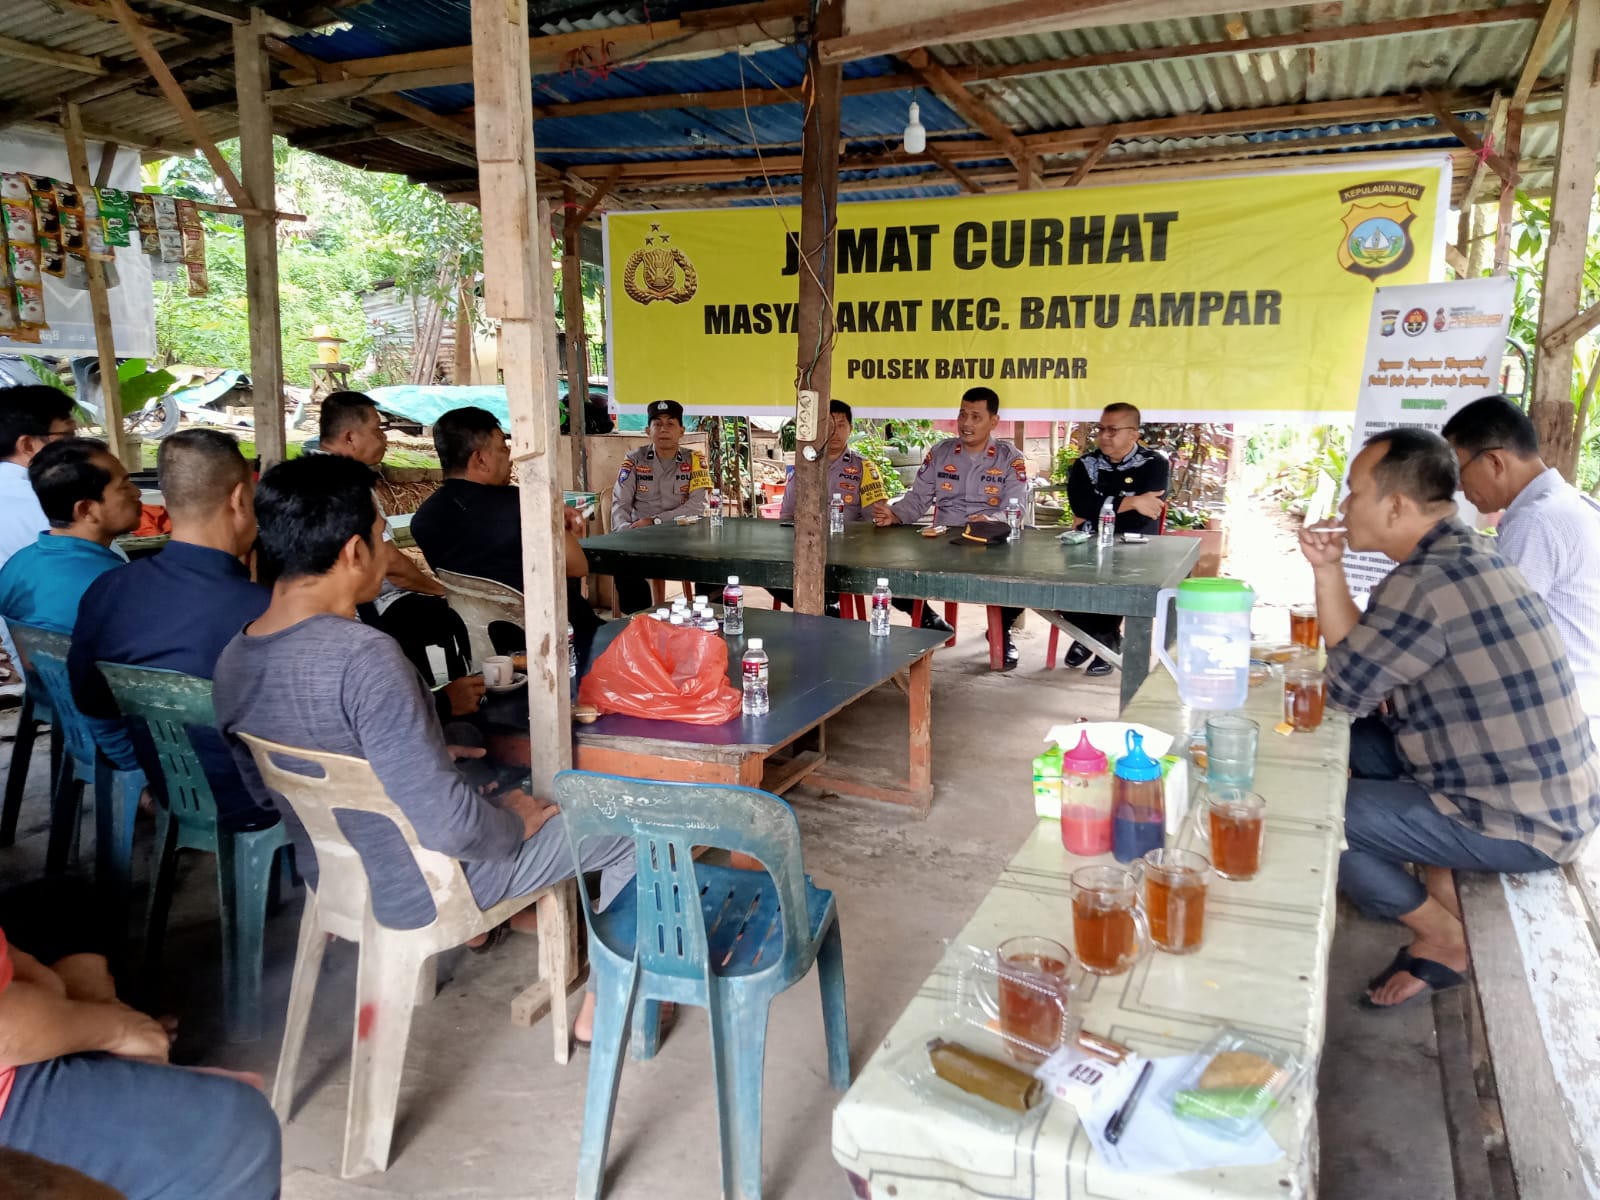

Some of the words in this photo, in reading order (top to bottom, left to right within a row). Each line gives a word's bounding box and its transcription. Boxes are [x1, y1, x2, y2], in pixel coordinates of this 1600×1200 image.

[1344, 184, 1396, 200] KEPULAUAN
[1398, 185, 1419, 196] RIAU
[781, 225, 939, 275] JMAT
[953, 211, 1179, 268] CURHAT
[704, 300, 922, 335] MASYAKAT
[931, 298, 1009, 331] KEC.
[1019, 294, 1121, 330] BATU
[1128, 290, 1282, 328] AMPAR
[848, 359, 929, 381] POLSEK
[935, 359, 995, 380] BATU
[1000, 357, 1087, 380] AMPAR
[980, 475, 1006, 484] POLRI
